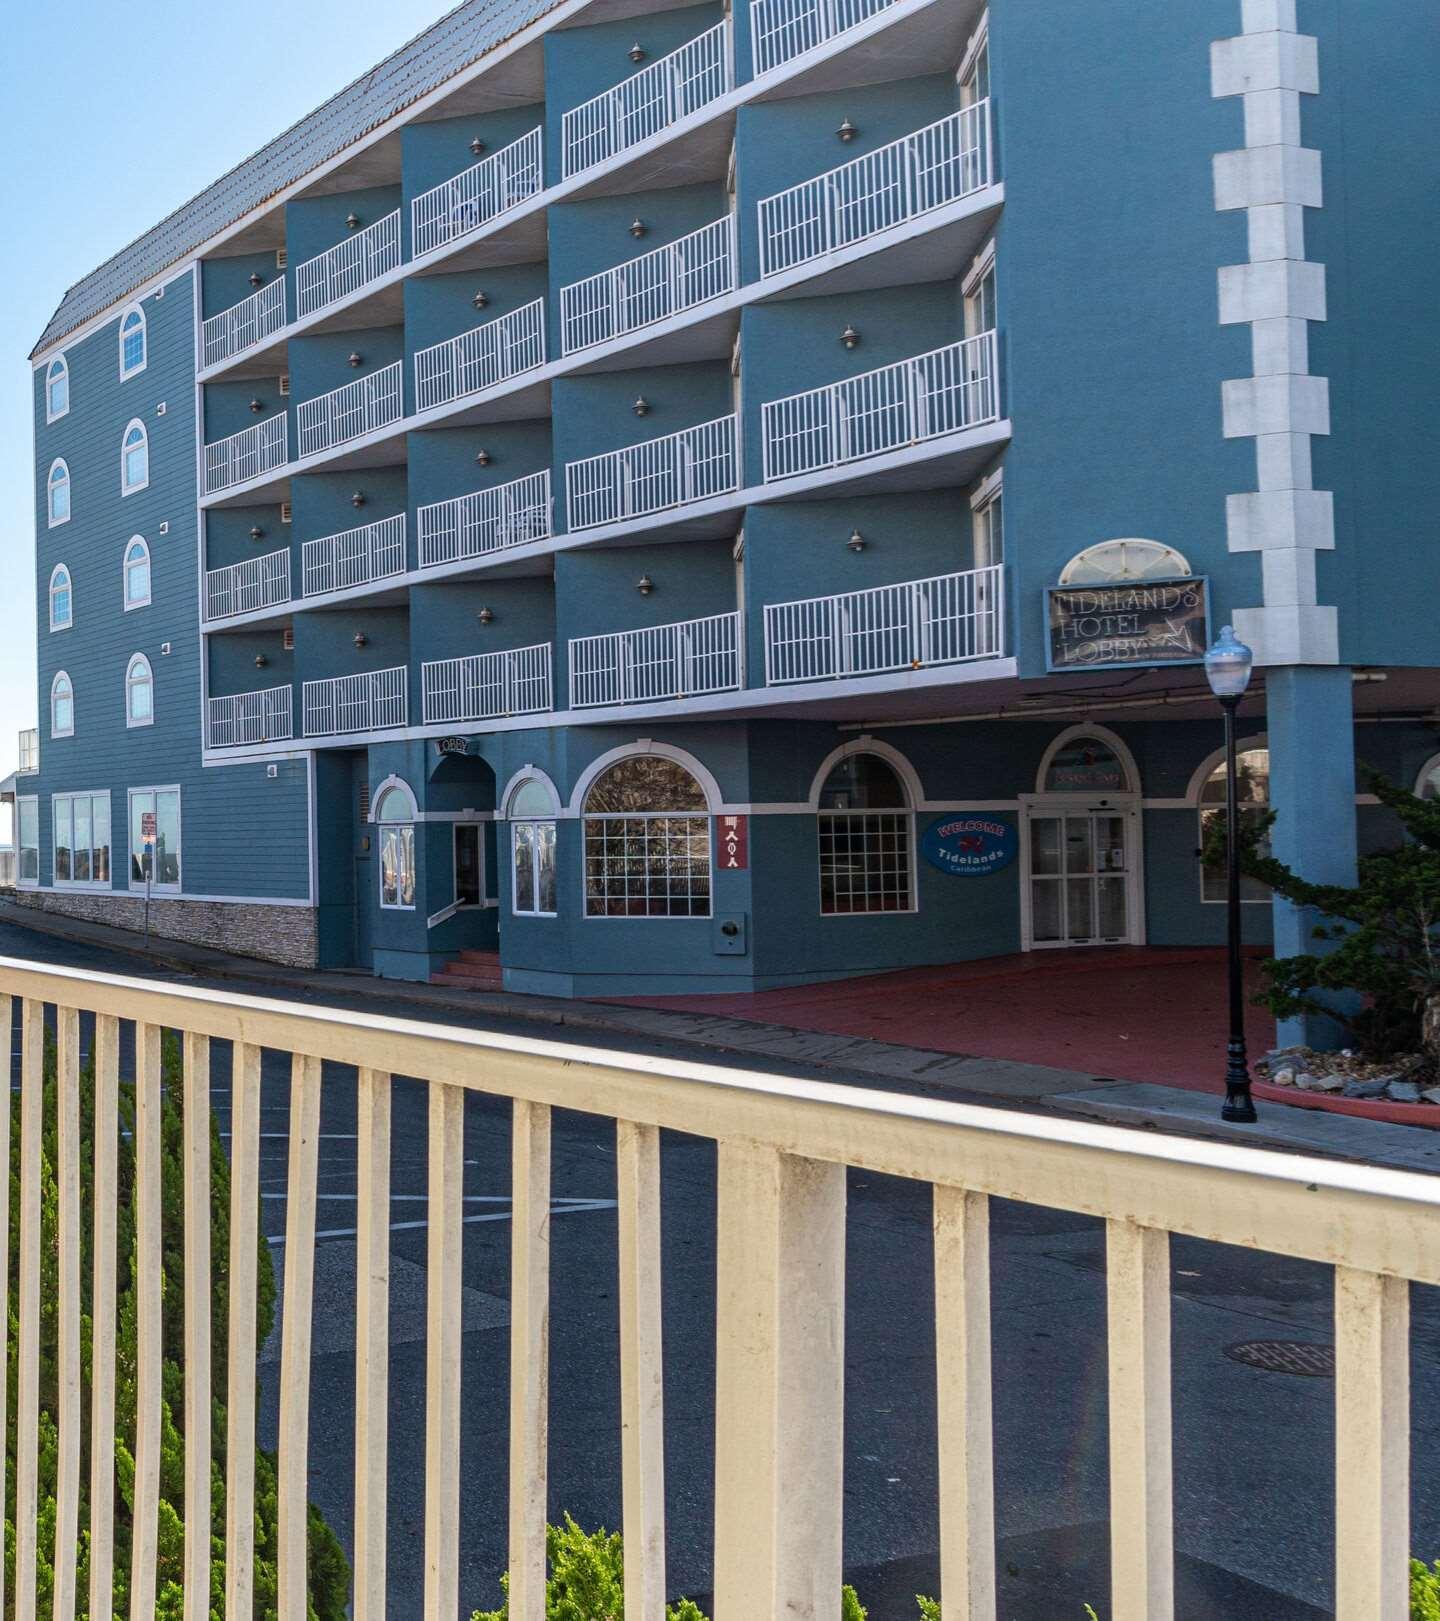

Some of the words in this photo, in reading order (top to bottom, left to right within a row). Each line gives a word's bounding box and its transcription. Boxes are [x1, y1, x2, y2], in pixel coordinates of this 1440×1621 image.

[1055, 588, 1200, 615] TIDELANDS
[1060, 615, 1146, 638] HOTEL
[1062, 640, 1142, 661] LOBBY
[937, 820, 1006, 838] WELCOME
[938, 848, 1004, 865] Tidelands
